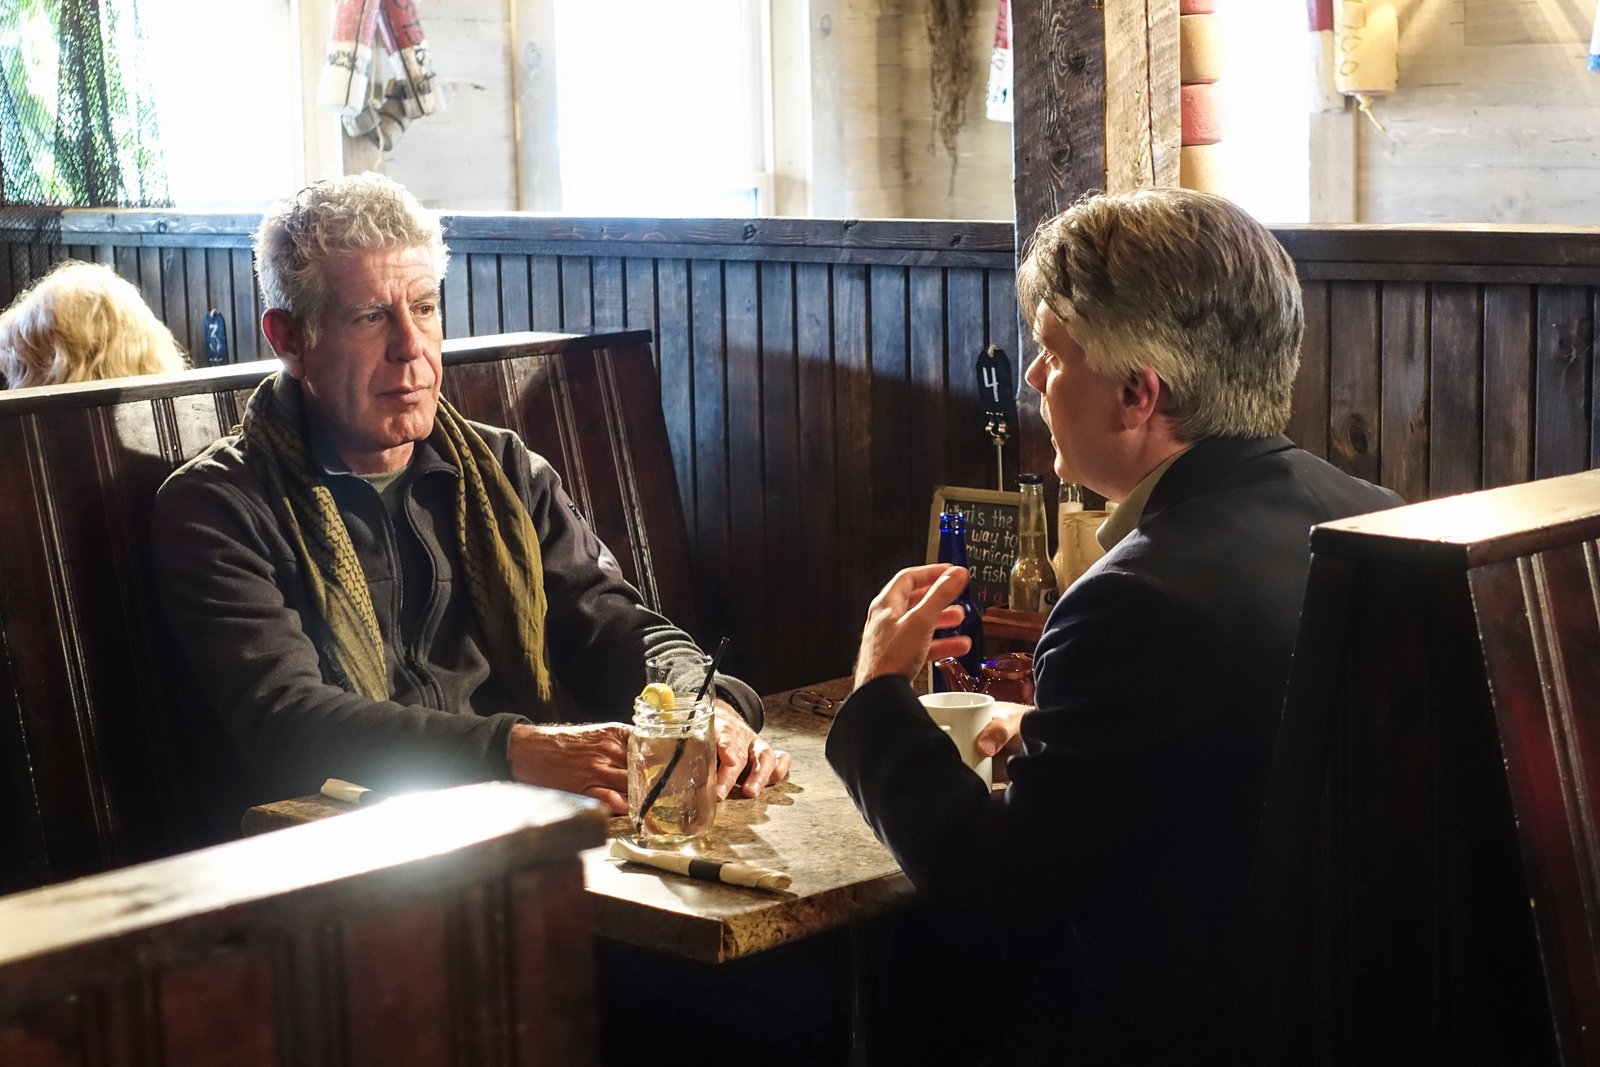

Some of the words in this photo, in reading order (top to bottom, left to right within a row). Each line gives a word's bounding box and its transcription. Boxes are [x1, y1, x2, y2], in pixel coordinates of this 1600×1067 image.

[208, 323, 222, 352] 3
[982, 366, 1000, 402] 4
[991, 509, 1014, 528] the
[971, 529, 999, 550] way
[1004, 530, 1018, 549] to
[969, 565, 977, 579] a
[982, 565, 1007, 583] fish
